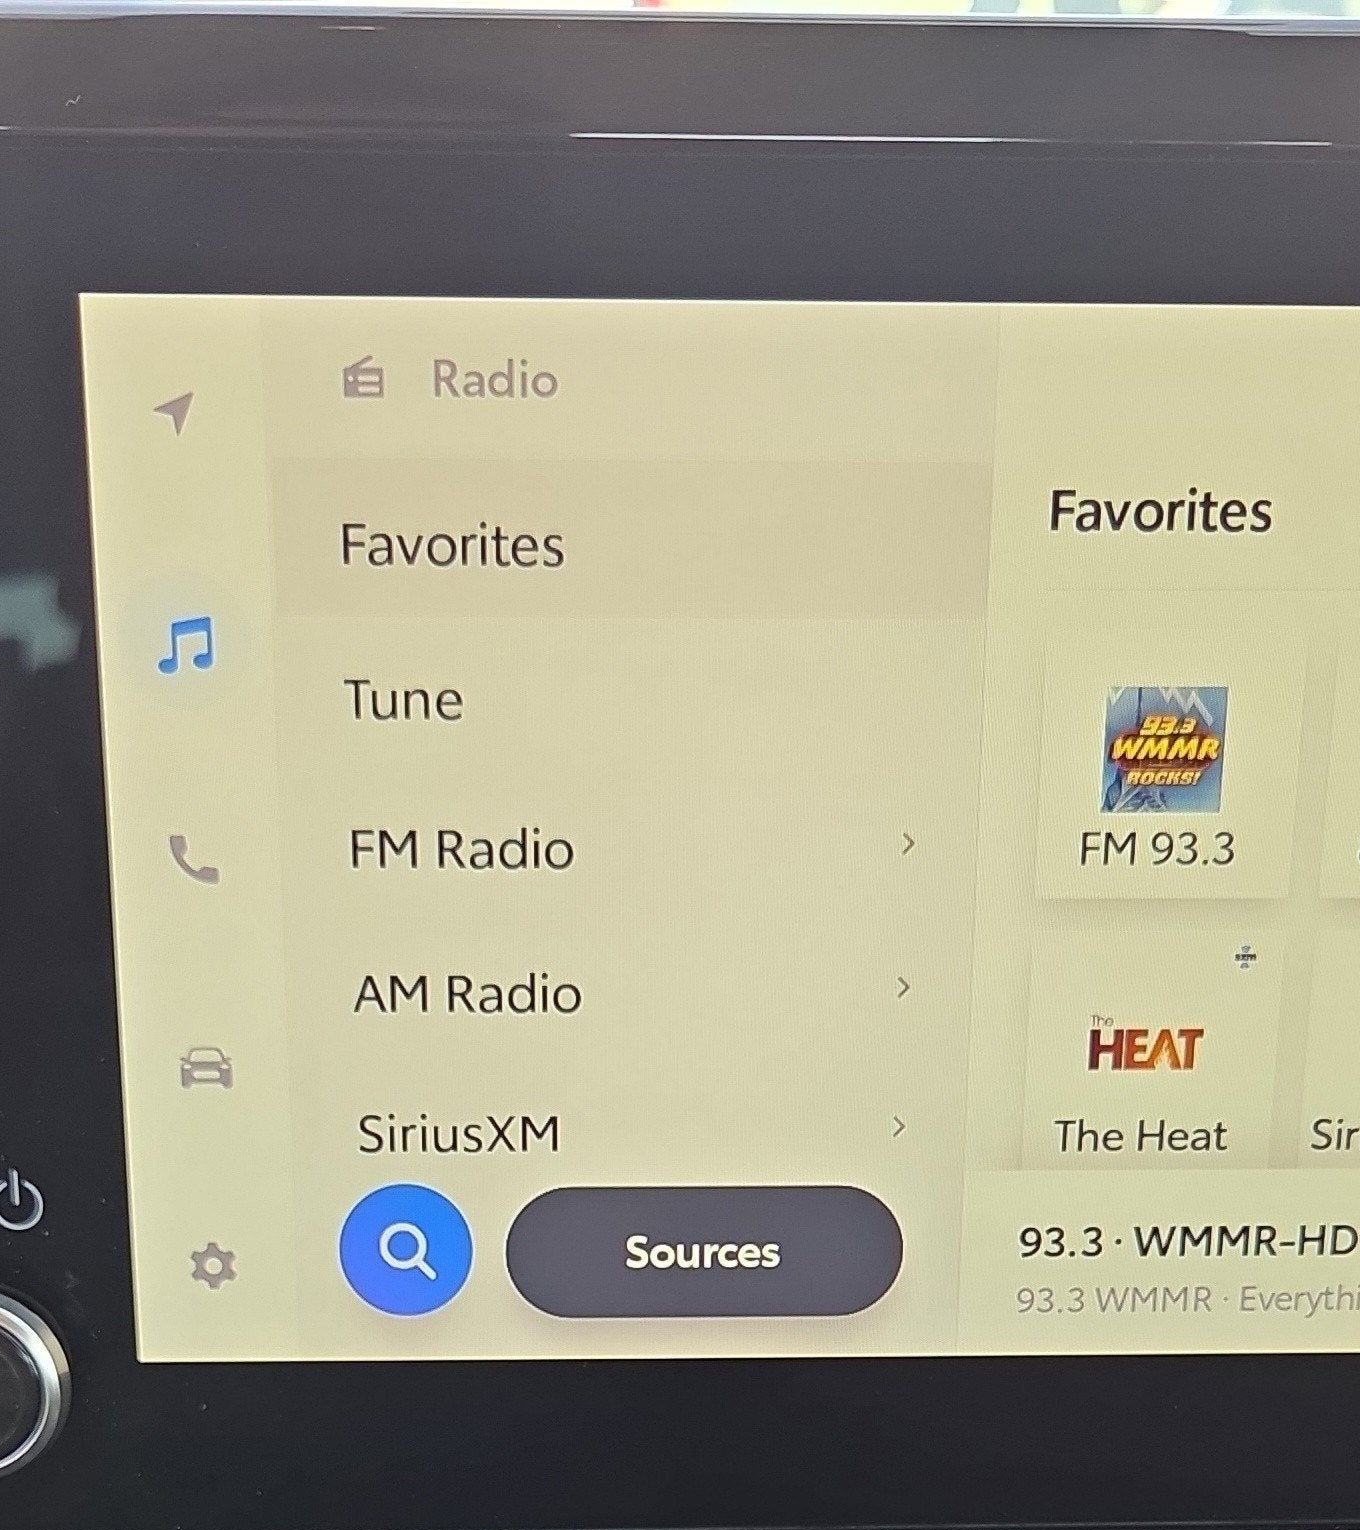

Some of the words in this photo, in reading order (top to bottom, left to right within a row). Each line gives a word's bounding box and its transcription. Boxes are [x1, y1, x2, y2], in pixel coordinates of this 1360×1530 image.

[434, 358, 557, 398] Radio
[1051, 487, 1272, 532] Favorites
[343, 521, 563, 567] Favorites
[344, 679, 462, 720] Tune
[1138, 713, 1200, 738] 93.3
[1109, 733, 1224, 763] WMMR
[1124, 768, 1203, 787] ROCKS!
[352, 830, 417, 868] FM
[438, 827, 573, 869] Radio
[1081, 832, 1136, 865] FM
[1152, 832, 1234, 865] 93.3
[354, 976, 427, 1012] AM
[448, 973, 581, 1013] Radio
[1088, 1029, 1204, 1070] HEAT
[360, 1114, 557, 1153] SiriusXM
[1055, 1119, 1123, 1152] The
[1138, 1120, 1227, 1151] Heat
[627, 1236, 780, 1268] Sources
[1020, 1227, 1102, 1257] 93.3
[1017, 1288, 1084, 1313] 93.3
[1096, 1287, 1212, 1312] WMMR
